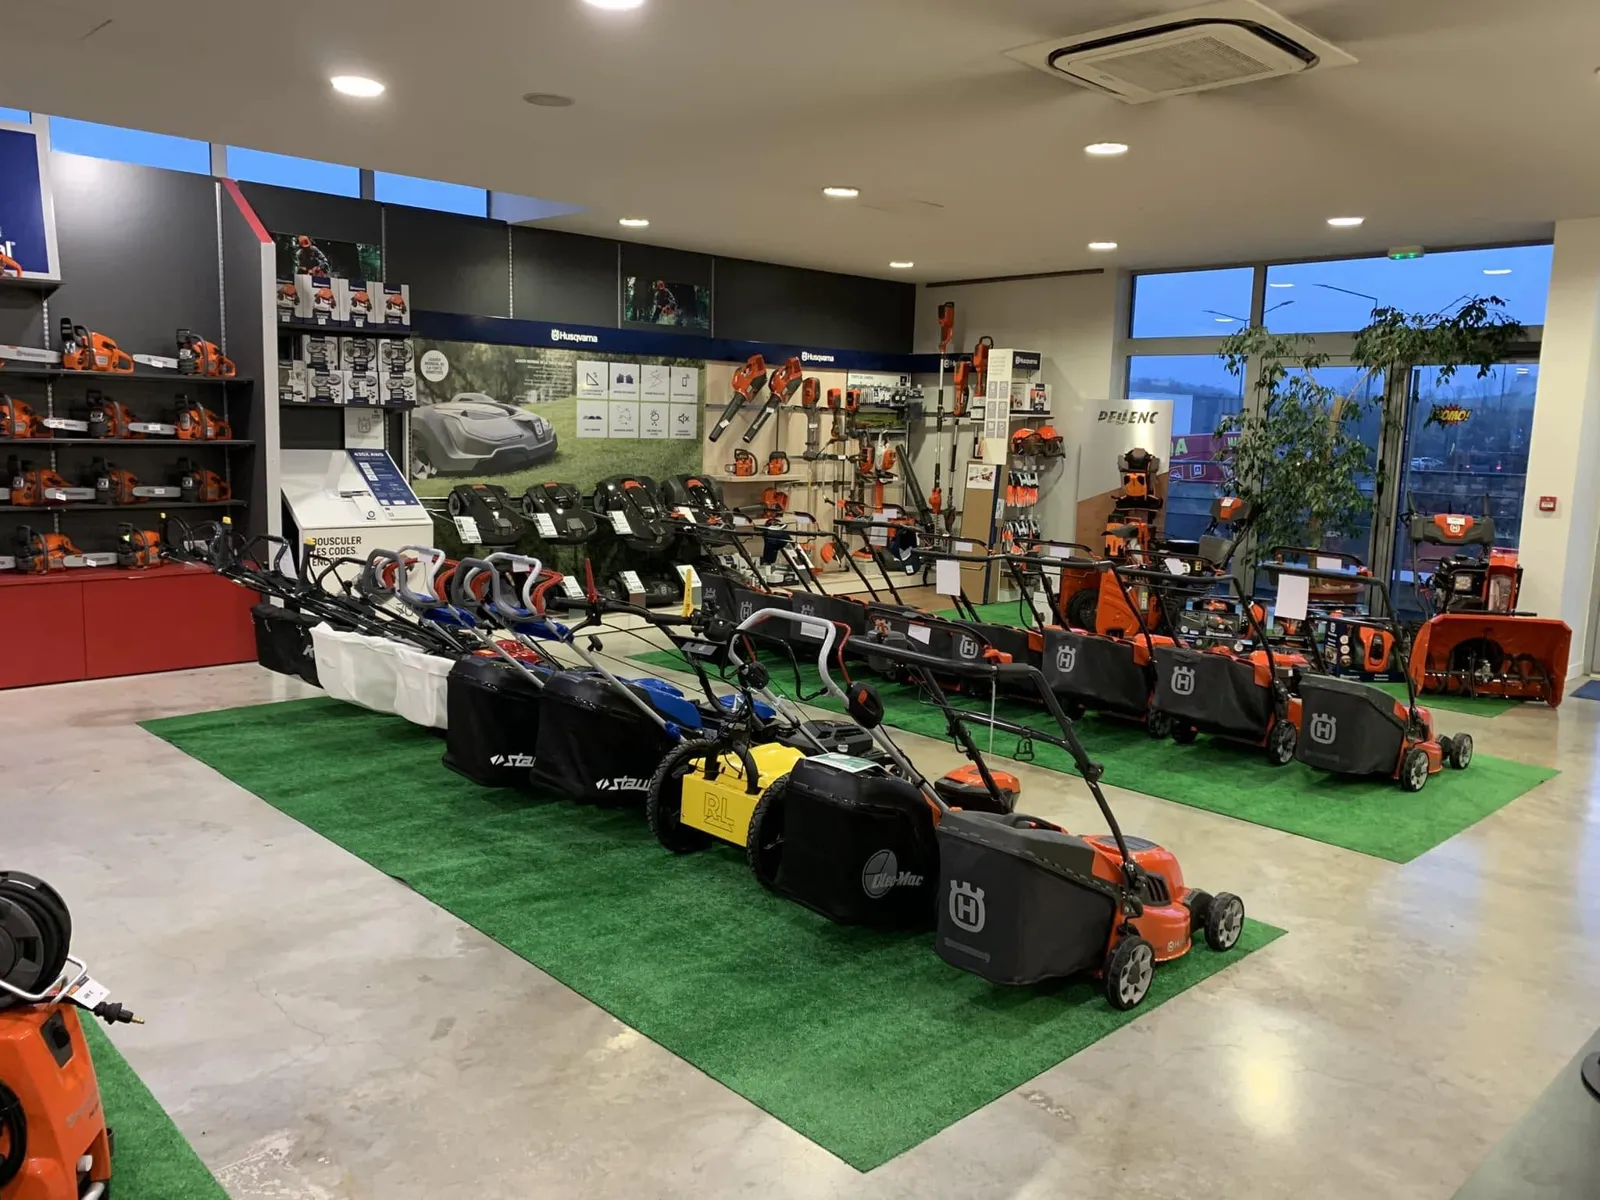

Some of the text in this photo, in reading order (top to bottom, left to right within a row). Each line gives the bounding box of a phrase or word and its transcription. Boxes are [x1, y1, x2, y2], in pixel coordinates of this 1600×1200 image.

[560, 332, 598, 343] Husqvarna
[807, 353, 835, 362] Husqvarna
[1432, 409, 1471, 421] OMO!
